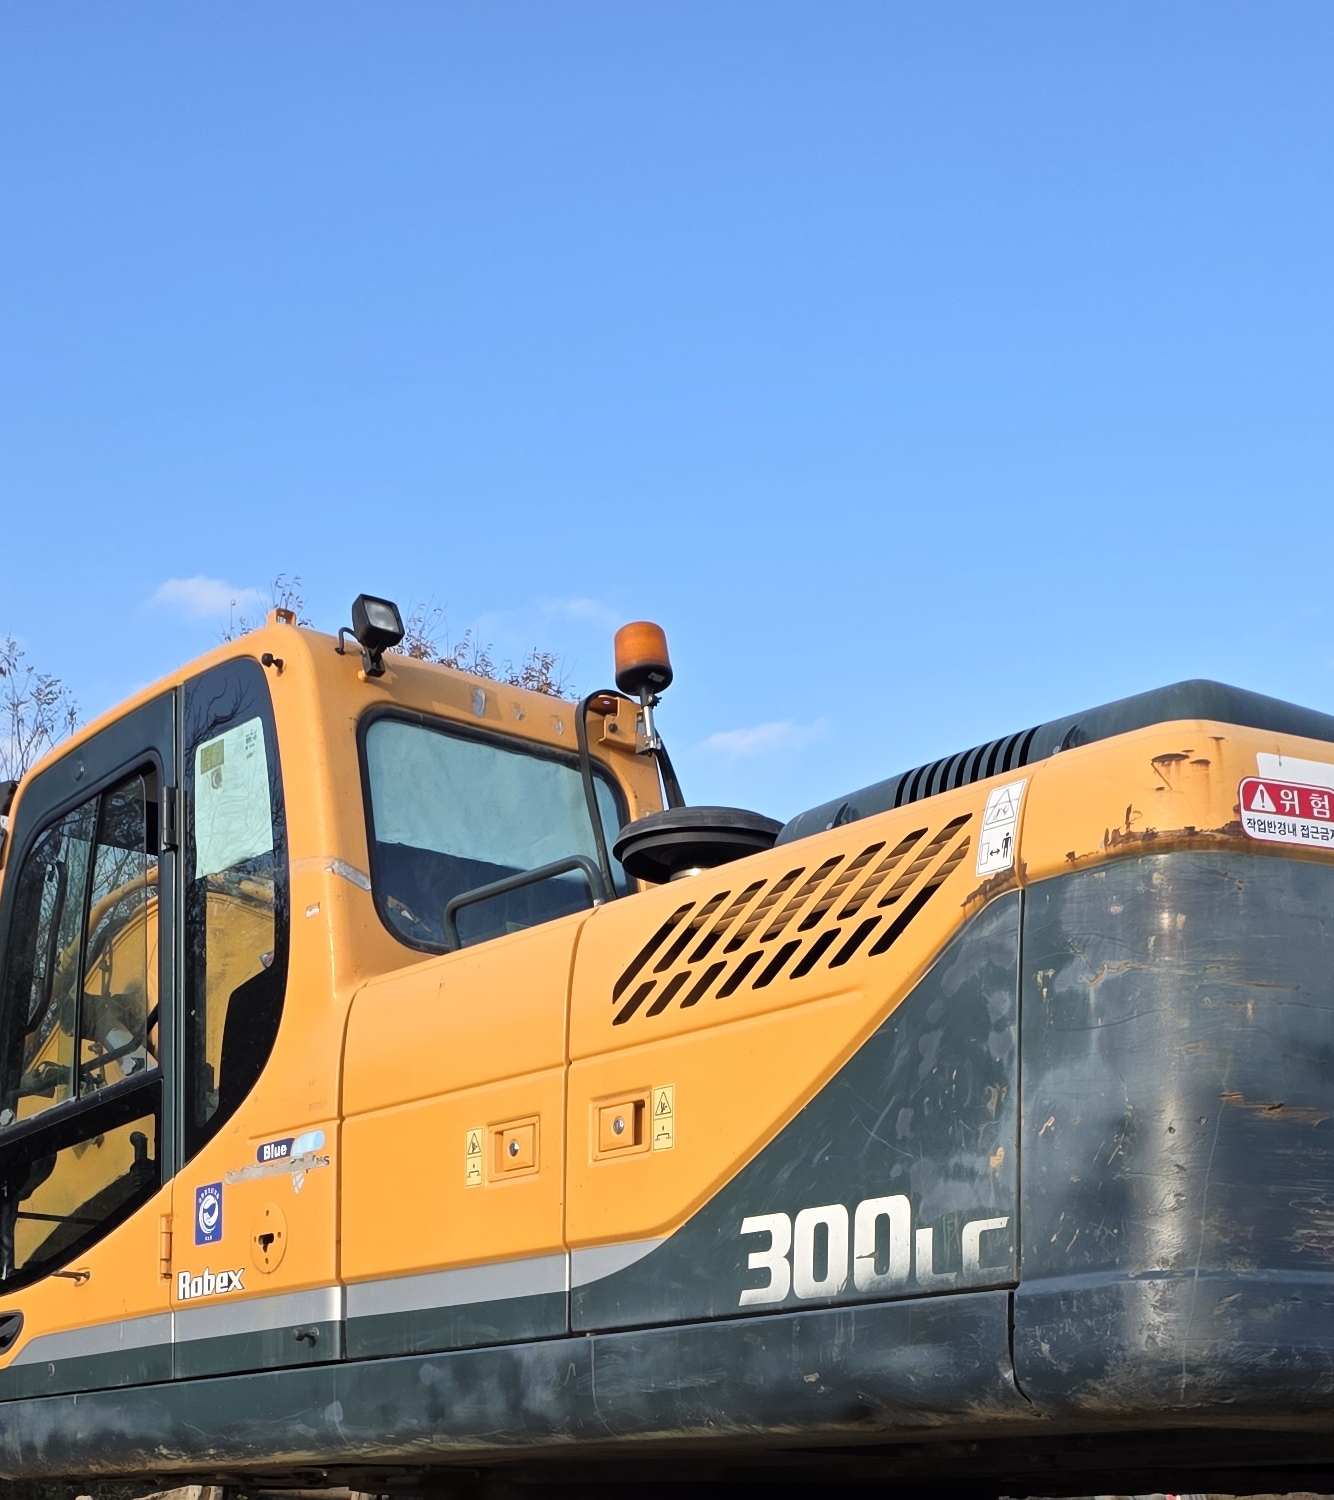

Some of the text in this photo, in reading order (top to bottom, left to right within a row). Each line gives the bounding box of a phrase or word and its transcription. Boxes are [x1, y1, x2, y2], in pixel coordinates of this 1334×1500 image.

[1246, 817, 1297, 837] 작업반경내
[263, 1143, 288, 1160] Blue
[738, 1193, 1011, 1307] 300LC
[177, 1267, 245, 1301] Robex
